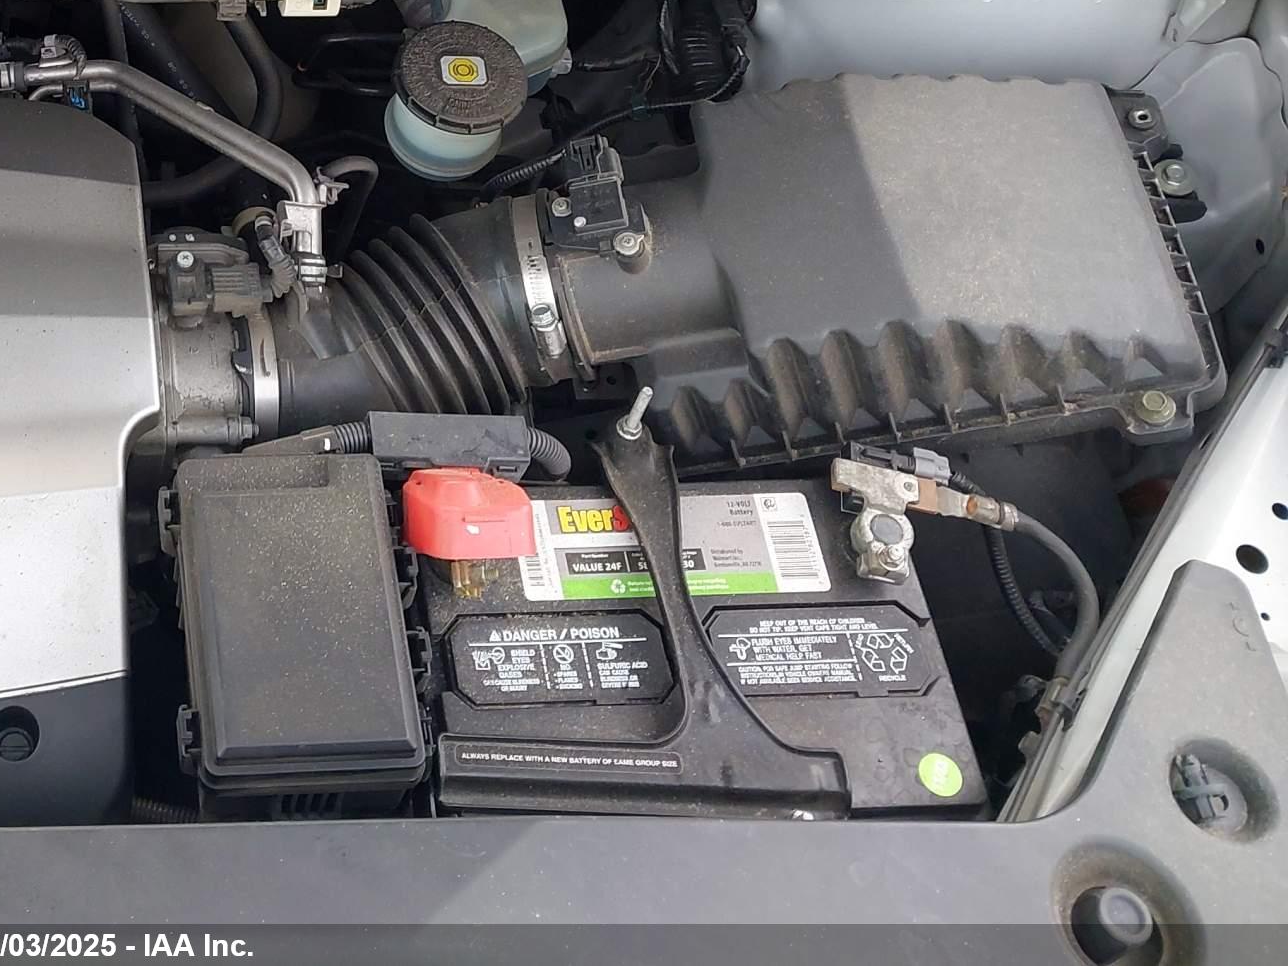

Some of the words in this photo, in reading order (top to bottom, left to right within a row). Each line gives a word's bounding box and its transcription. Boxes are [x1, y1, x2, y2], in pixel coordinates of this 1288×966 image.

[572, 562, 604, 572] VALUE
[605, 561, 623, 571] 24F
[503, 628, 557, 641] DANGER
[560, 628, 568, 641] /
[571, 626, 620, 640] POISON
[752, 638, 773, 646] FLUSH
[774, 637, 792, 645] EYES
[793, 636, 837, 644] IMMEDIATELY
[753, 646, 771, 654] WITH
[755, 653, 786, 661] MEDICAL
[787, 652, 804, 660] HELP
[805, 651, 822, 660] FAST
[878, 674, 907, 682] RECYCLE
[491, 754, 523, 762] REPLACE
[569, 757, 601, 765] BATTERY
[635, 759, 660, 767] GROUP
